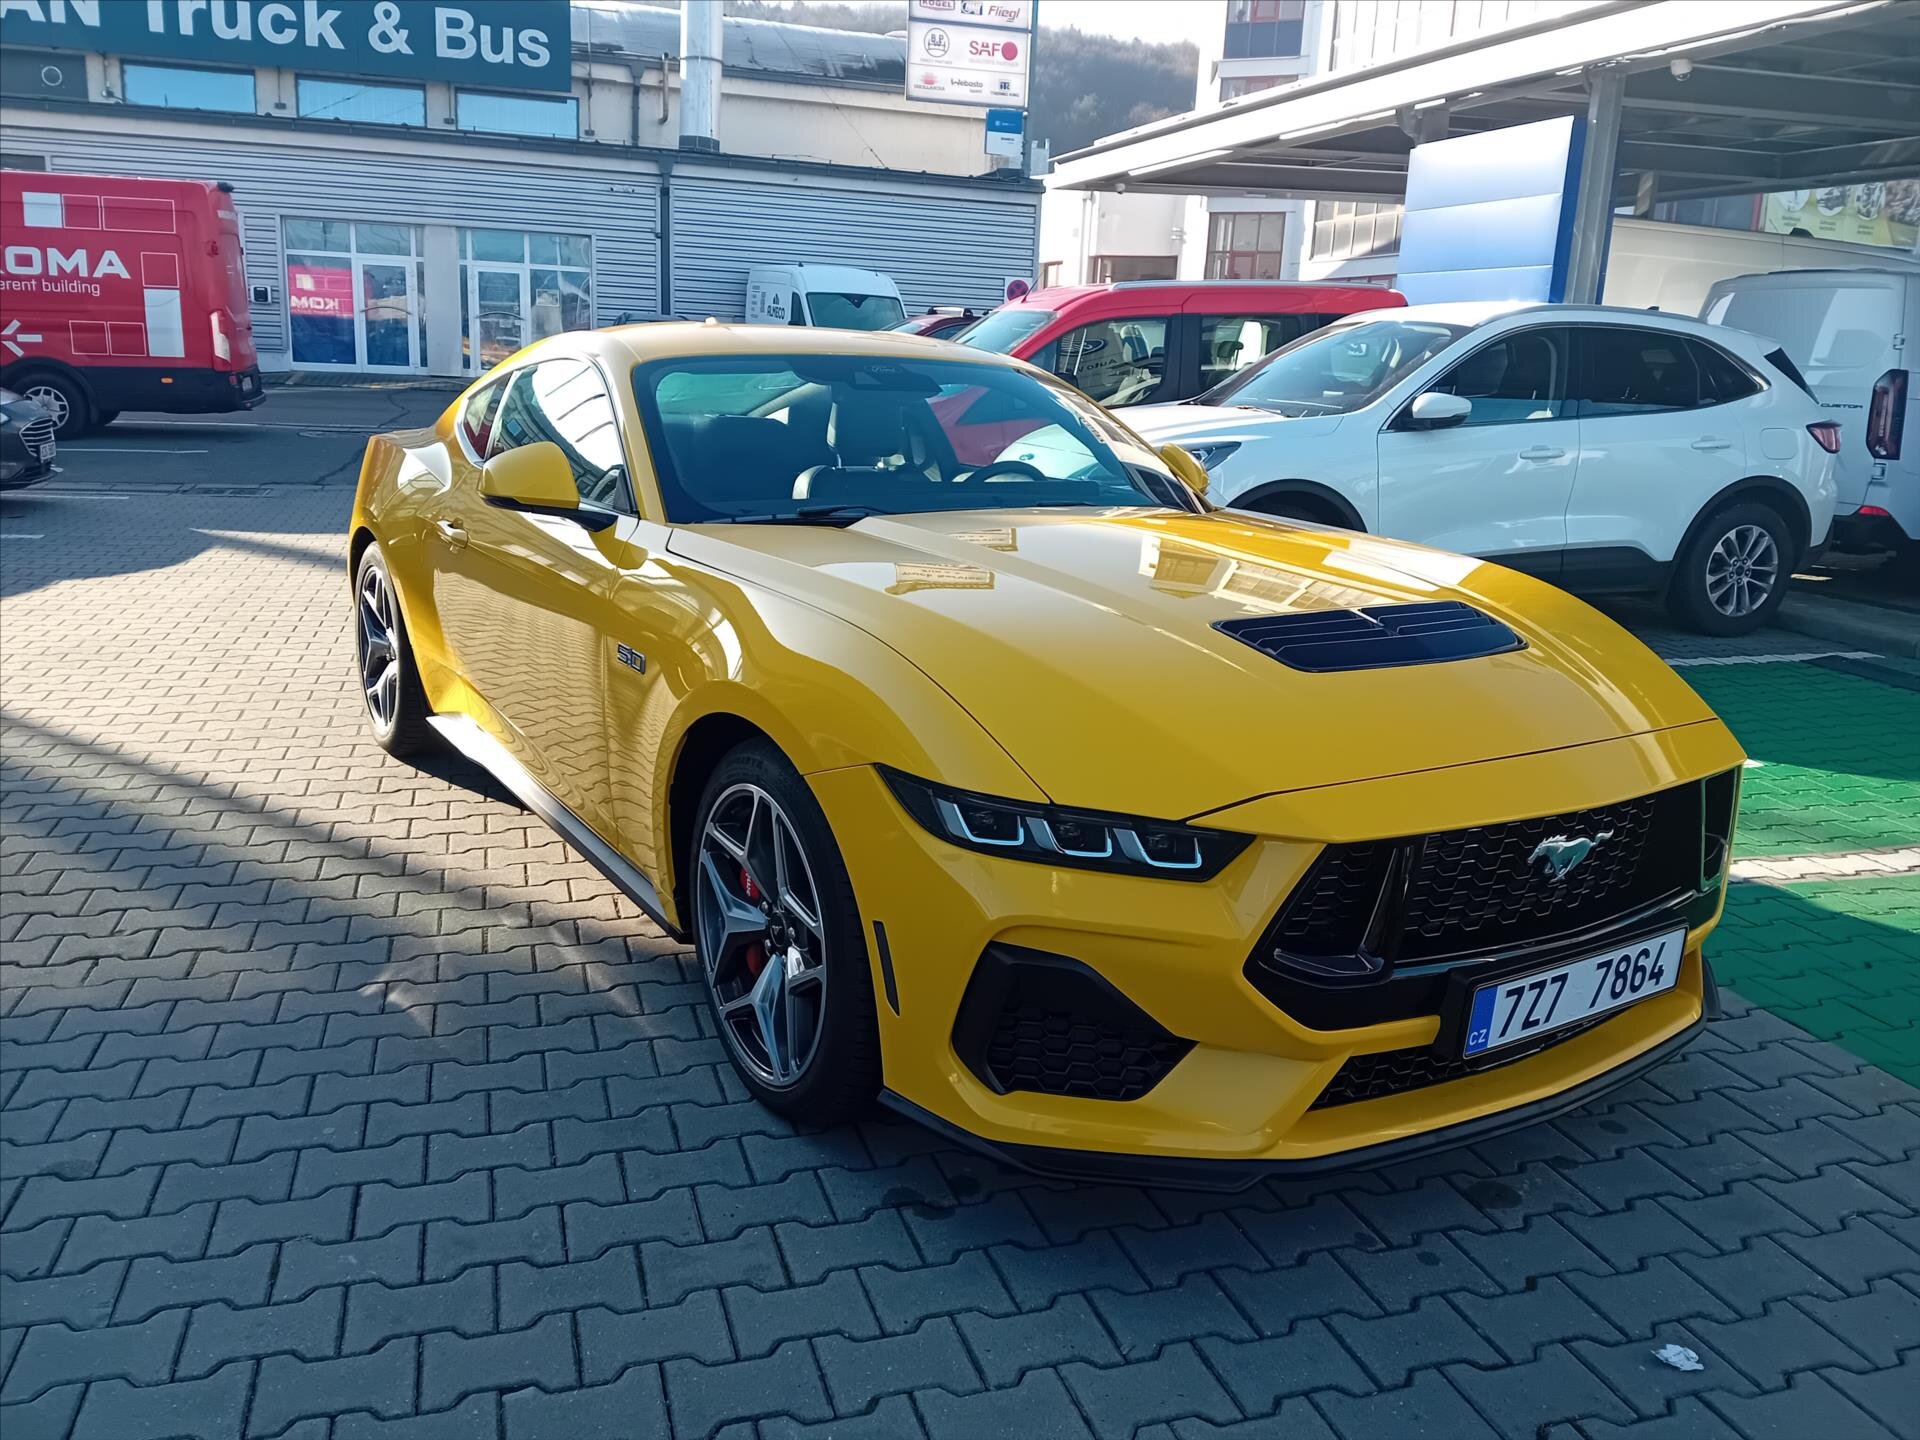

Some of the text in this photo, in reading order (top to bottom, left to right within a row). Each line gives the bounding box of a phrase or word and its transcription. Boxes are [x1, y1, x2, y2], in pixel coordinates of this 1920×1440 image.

[368, 1, 415, 55] &
[435, 7, 551, 68] Bus
[42, 279, 101, 297] building
[1498, 941, 1666, 1039] 7Z7 7864
[1469, 1029, 1487, 1046] CZ
